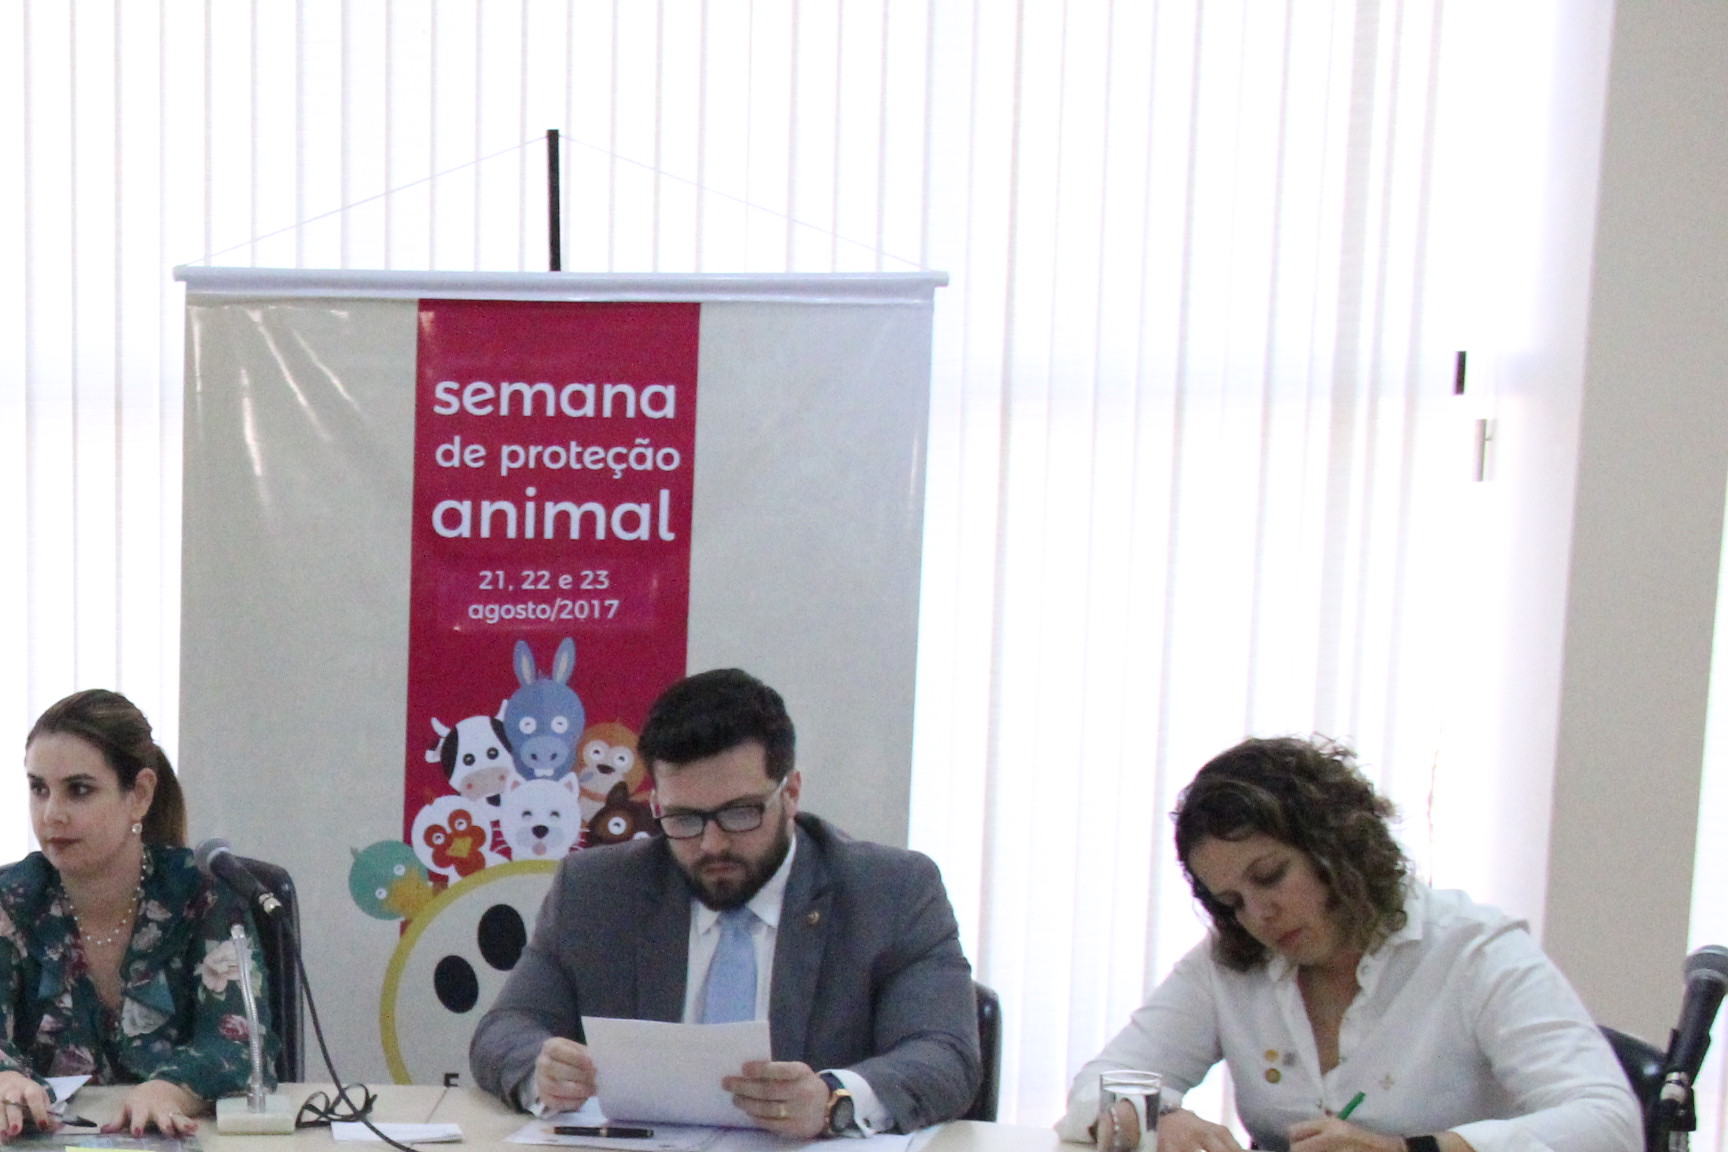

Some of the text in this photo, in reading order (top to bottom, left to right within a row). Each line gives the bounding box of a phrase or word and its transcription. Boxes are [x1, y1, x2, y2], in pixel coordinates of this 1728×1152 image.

[433, 380, 676, 419] semana
[435, 435, 681, 479] de proteção
[431, 486, 675, 542] animal
[521, 570, 551, 590] 22
[558, 573, 573, 590] e
[580, 570, 610, 590] 23
[468, 598, 620, 624] agosto/2017
